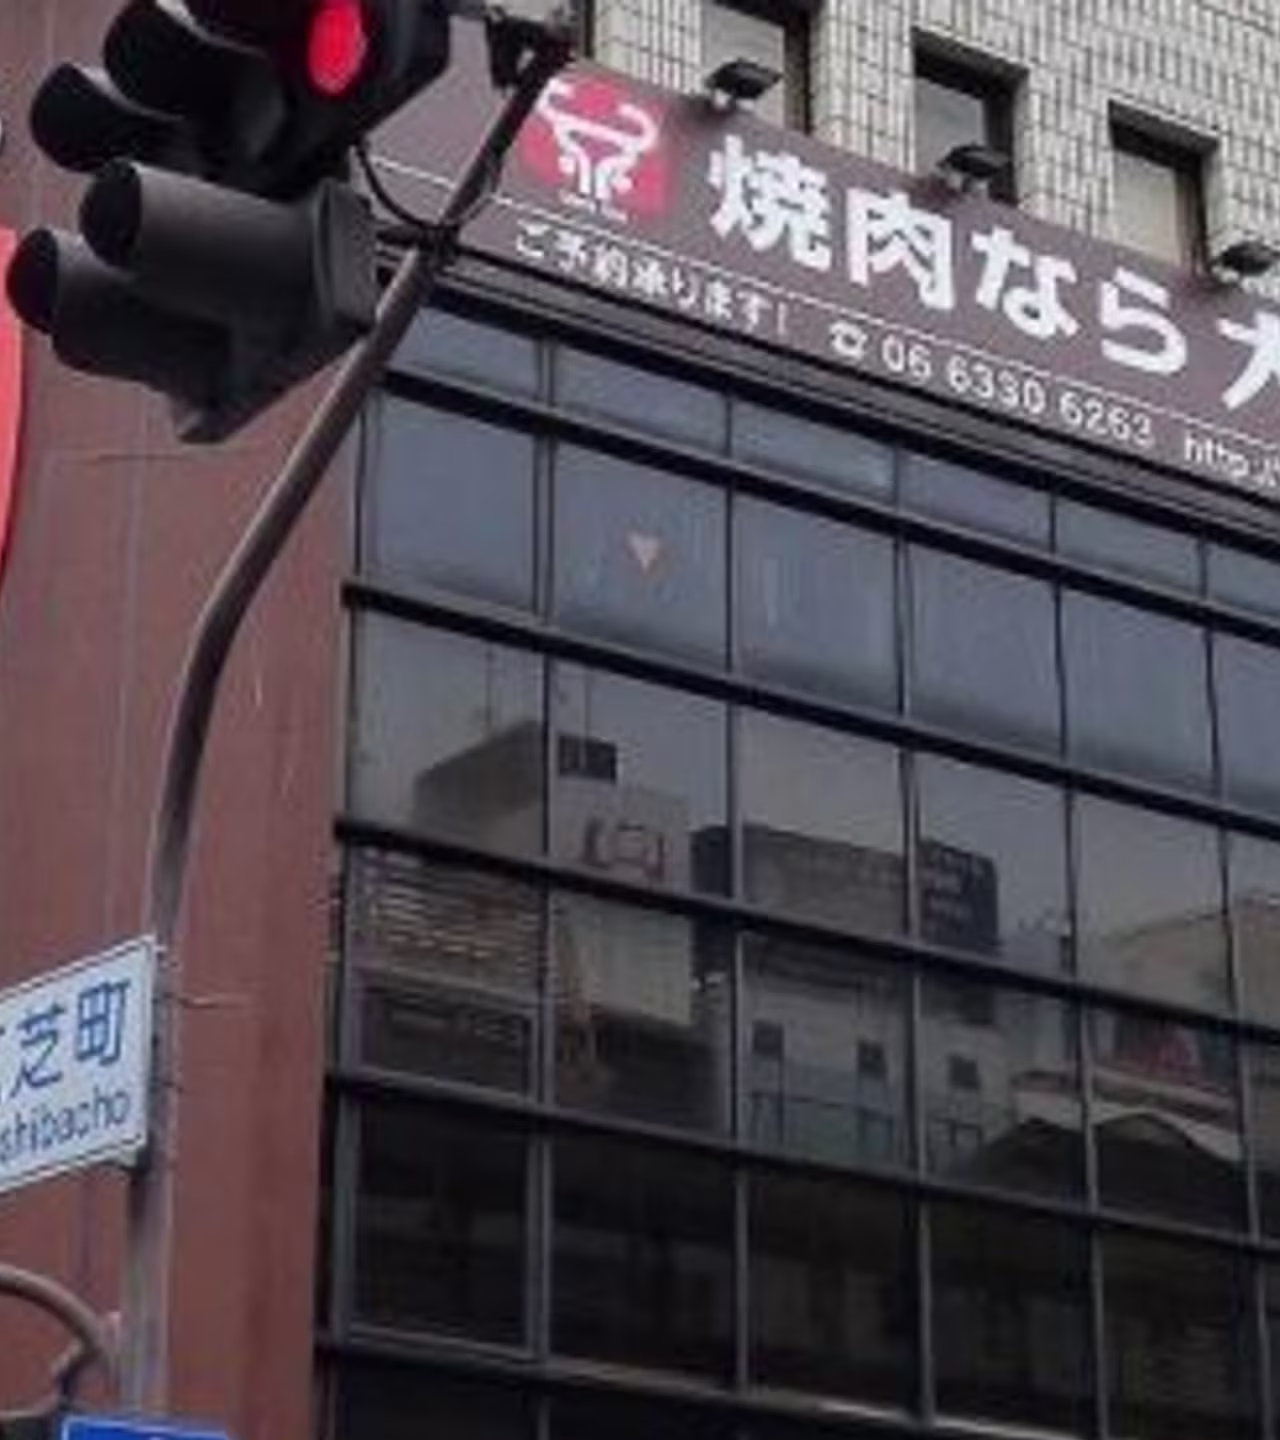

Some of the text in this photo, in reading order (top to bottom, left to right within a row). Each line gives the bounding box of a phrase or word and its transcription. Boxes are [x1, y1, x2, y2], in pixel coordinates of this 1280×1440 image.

[708, 134, 1188, 376] 焼肉なら
[881, 338, 933, 382] 06
[947, 354, 1048, 416] 6330
[1060, 392, 1155, 447] 6263
